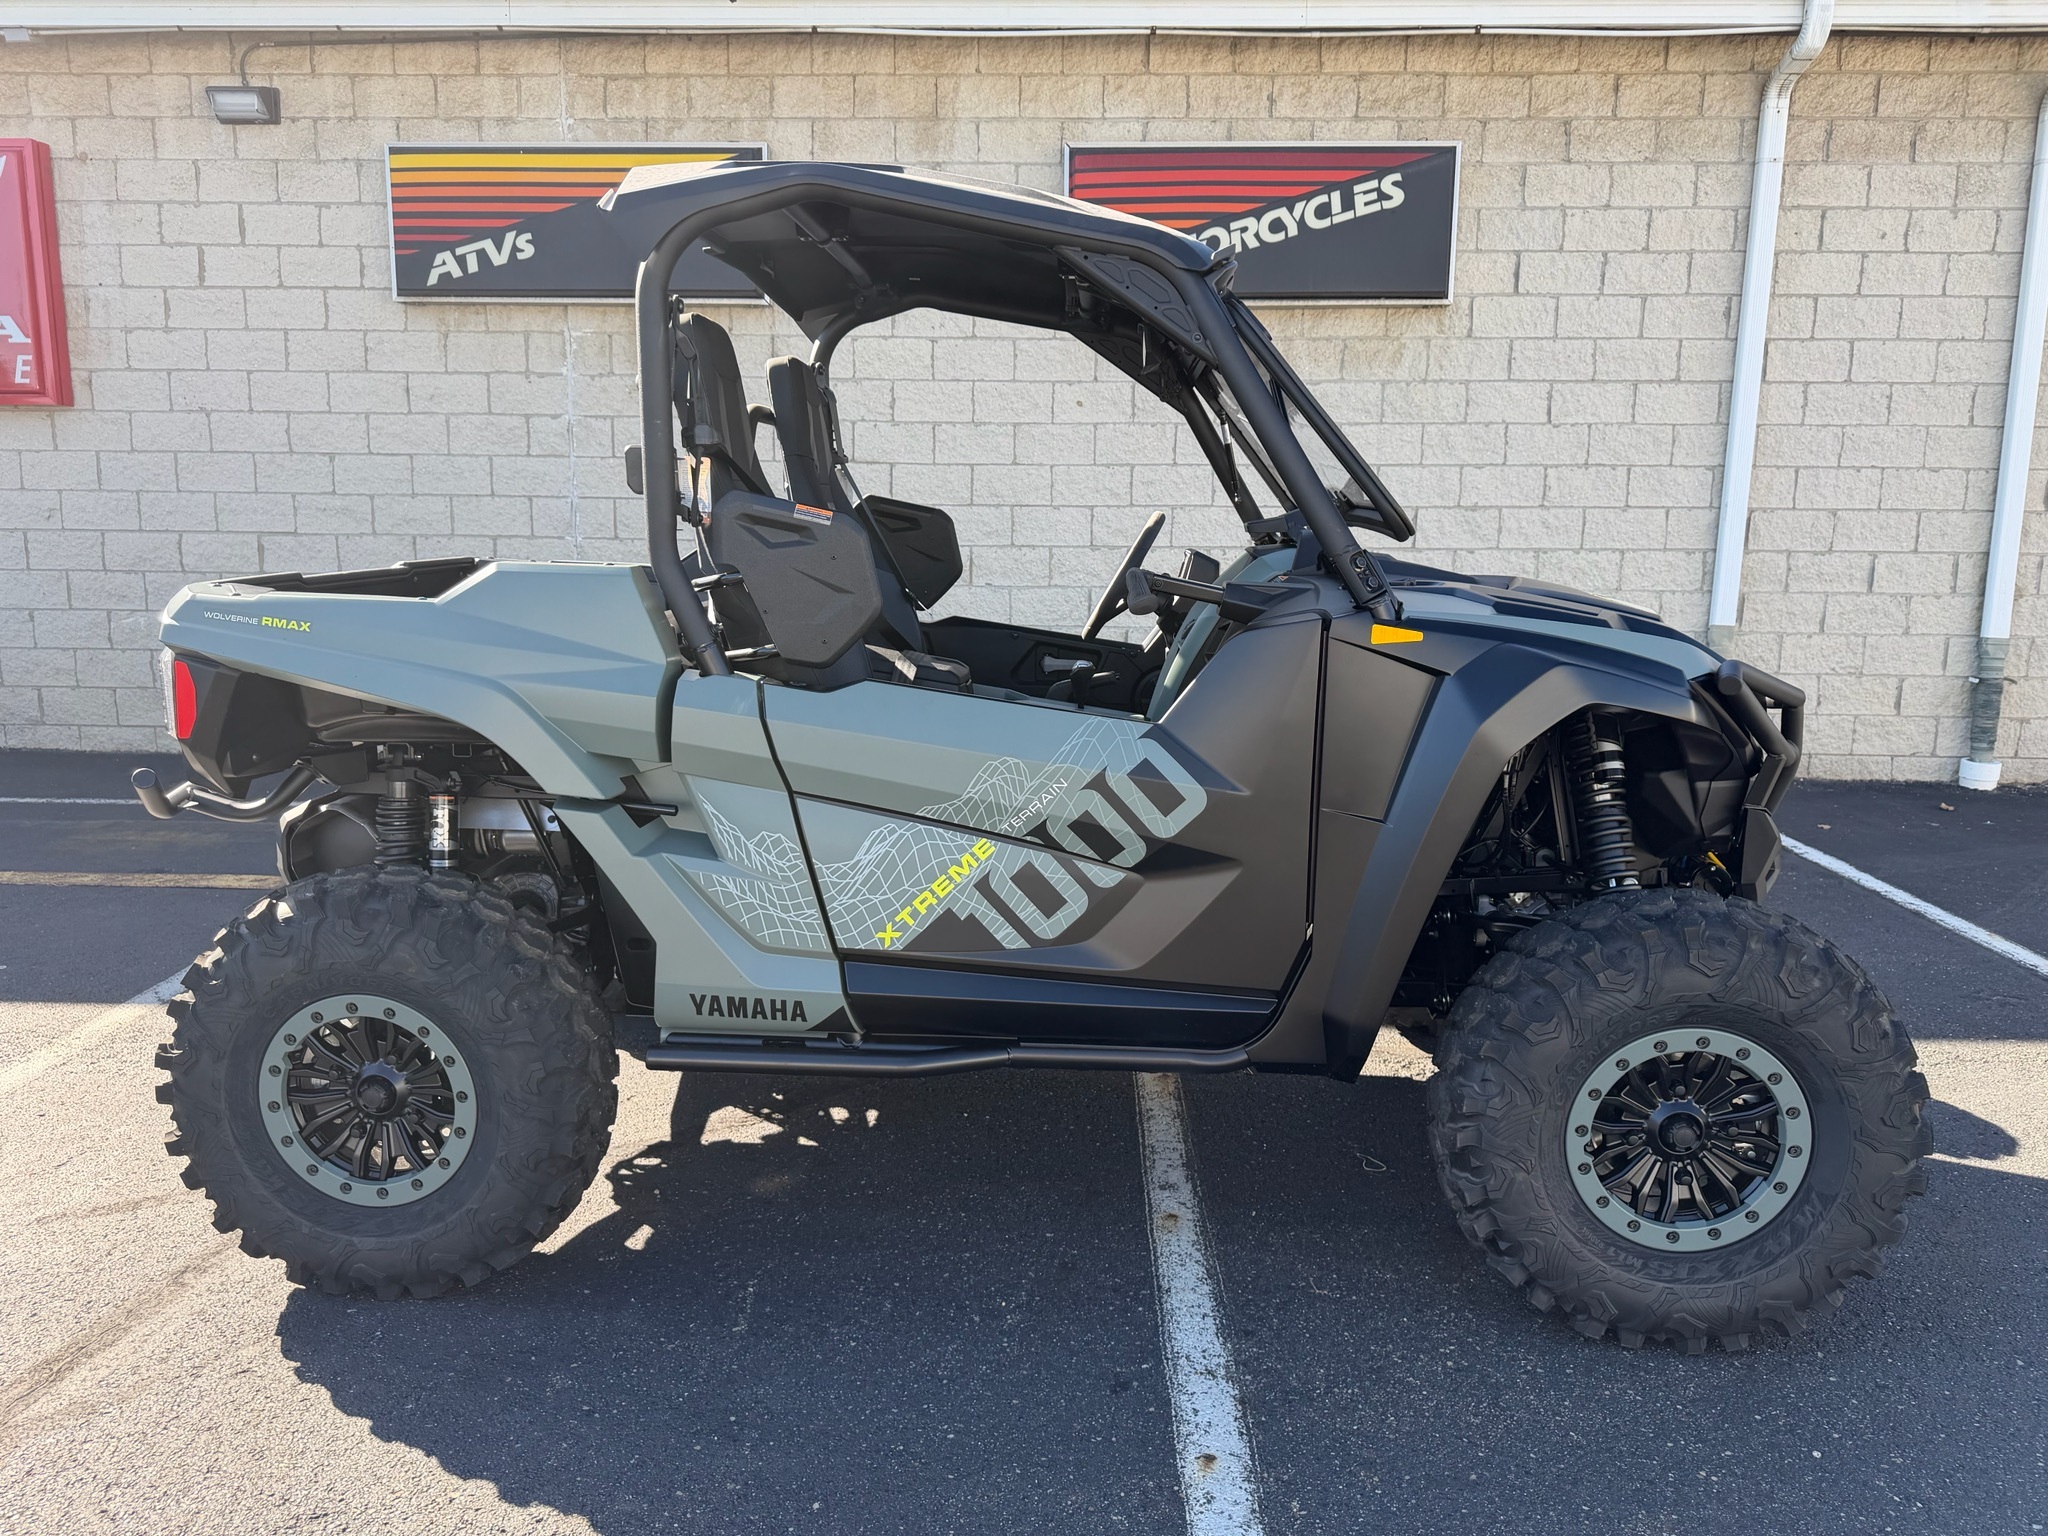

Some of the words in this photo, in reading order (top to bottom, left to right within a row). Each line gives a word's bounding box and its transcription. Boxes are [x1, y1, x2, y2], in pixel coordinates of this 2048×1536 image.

[1188, 172, 1405, 255] ORCYCLES
[203, 611, 259, 625] WOLVERINE
[261, 616, 312, 632] RMAX
[875, 837, 996, 949] XTREME
[1000, 777, 1069, 833] TERRAIN
[950, 737, 1208, 950] 1000
[689, 993, 808, 1023] YAMAHA
[1554, 1010, 1679, 1105] CARNIVORE
